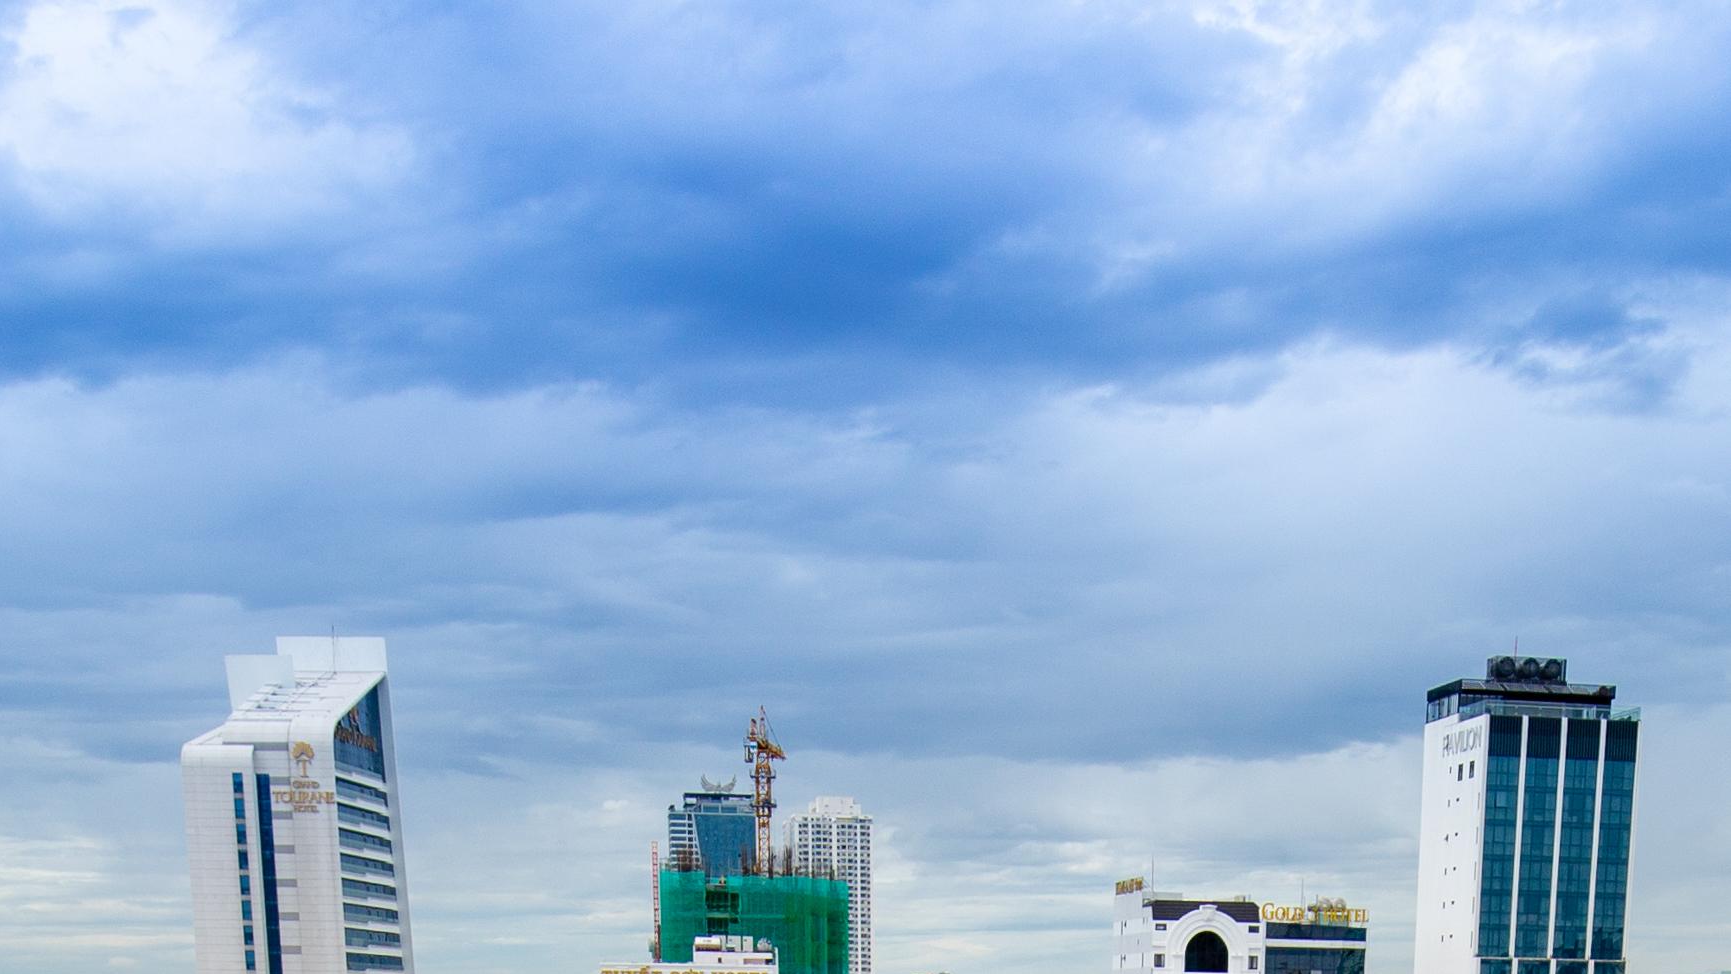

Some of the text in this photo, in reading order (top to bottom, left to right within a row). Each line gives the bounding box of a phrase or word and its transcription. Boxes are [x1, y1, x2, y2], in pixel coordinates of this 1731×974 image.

[1442, 725, 1482, 758] PAVILION
[272, 791, 335, 804] TOURANE
[1261, 902, 1304, 922] GOLD
